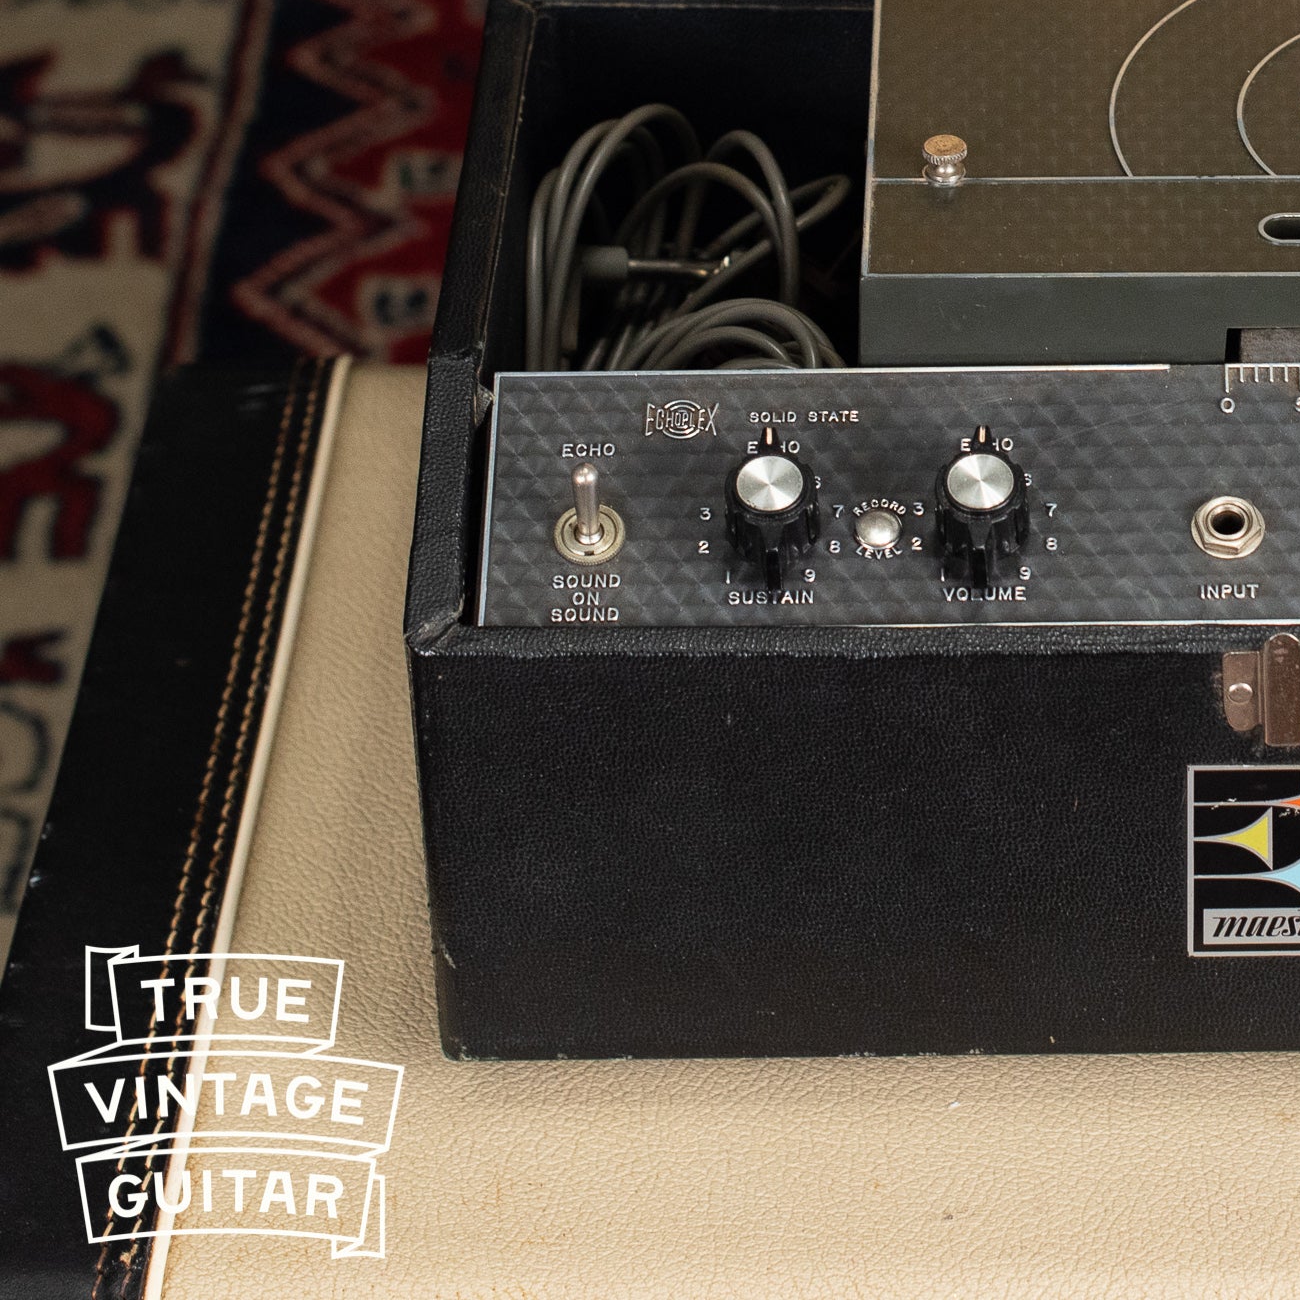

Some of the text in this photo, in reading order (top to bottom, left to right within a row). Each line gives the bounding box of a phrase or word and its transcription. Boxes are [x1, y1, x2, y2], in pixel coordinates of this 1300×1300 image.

[1220, 397, 1235, 413] 0
[645, 402, 719, 436] ECHOPLEX
[750, 411, 859, 423] SOLID STATE
[562, 443, 615, 457] ECHO
[747, 441, 800, 454] EHO
[960, 438, 1013, 451] EHO
[700, 508, 711, 520] 3
[833, 505, 844, 518] 7
[853, 499, 907, 516] RECORD
[913, 502, 924, 516] 3
[1046, 503, 1057, 517] 7
[698, 540, 710, 554] 2
[830, 540, 841, 553] 8
[911, 537, 923, 551] 2
[1046, 537, 1057, 550] 8
[855, 548, 902, 560] LEVEL
[804, 569, 816, 583] 9
[1019, 566, 1031, 580] 9
[552, 574, 621, 589] SOUND
[572, 592, 600, 605] ON
[728, 590, 814, 605] SUSTAIN
[1200, 584, 1259, 600] INPUT
[551, 608, 619, 622] SOUND
